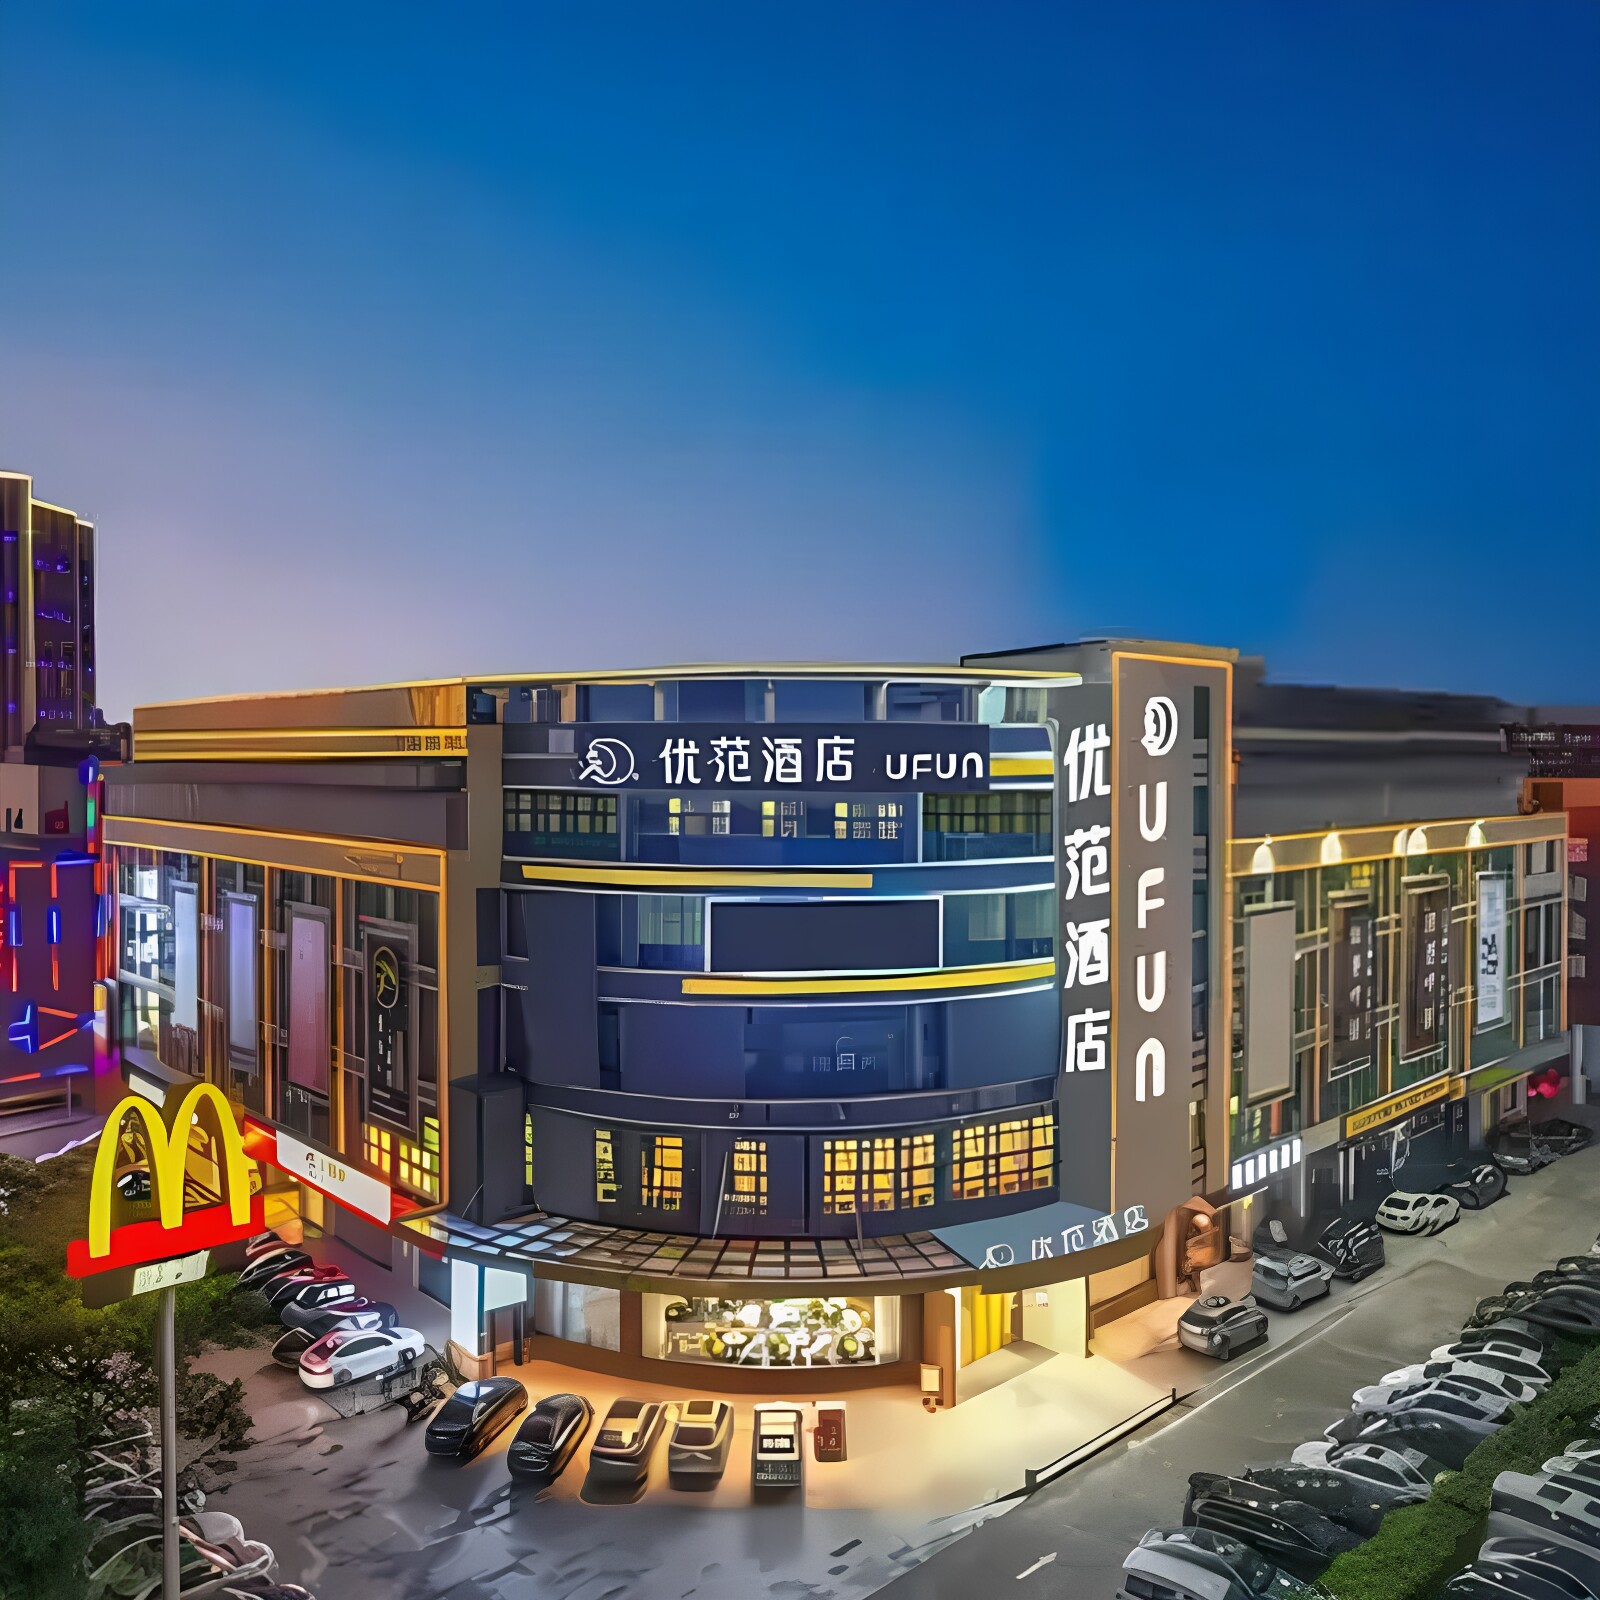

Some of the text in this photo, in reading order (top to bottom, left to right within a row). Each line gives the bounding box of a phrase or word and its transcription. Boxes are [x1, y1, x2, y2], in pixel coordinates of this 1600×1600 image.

[658, 735, 855, 785] 优范酒店
[1063, 723, 1111, 1073] 优范酒店
